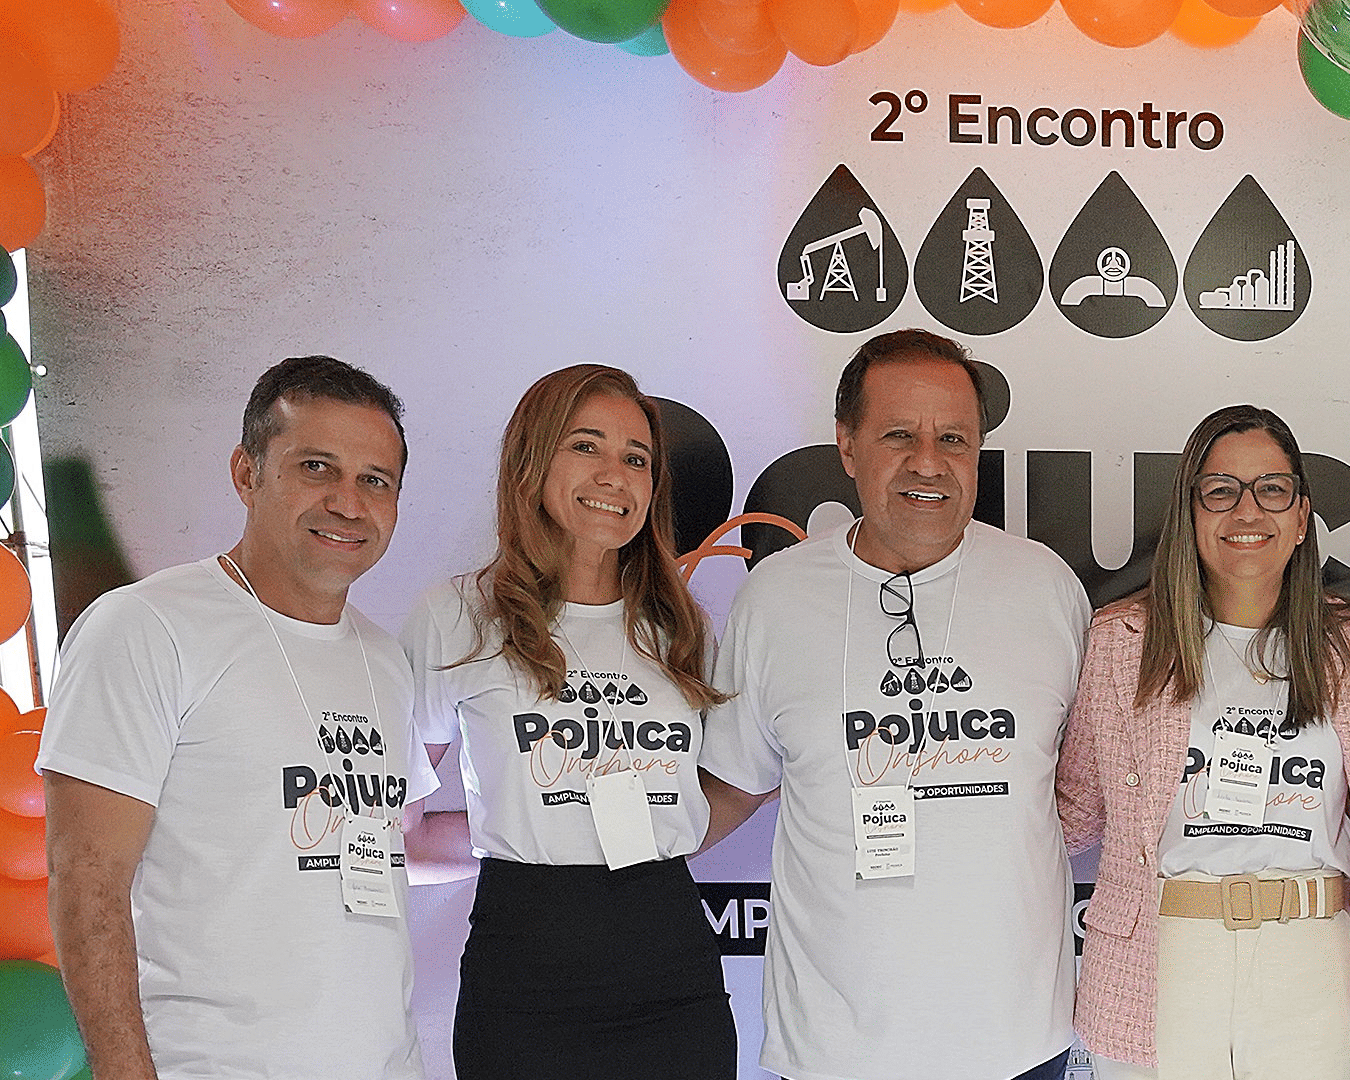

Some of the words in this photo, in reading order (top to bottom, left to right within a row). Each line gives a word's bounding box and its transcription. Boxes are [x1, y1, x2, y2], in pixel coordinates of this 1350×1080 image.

[948, 94, 1224, 150] Encontro
[905, 656, 954, 664] Enontro
[332, 712, 369, 724] Encontro
[843, 698, 1015, 753] Pojuca
[512, 707, 692, 760] Pojuca
[857, 726, 1010, 786] Onshore
[1220, 758, 1263, 774] Pojuca
[282, 758, 407, 815] Pojuca
[927, 784, 1004, 797] OPORTUNIDADES
[862, 812, 907, 826] Pojuca
[1188, 825, 1239, 836] AMPLIANDO
[348, 843, 384, 859] Pojuca
